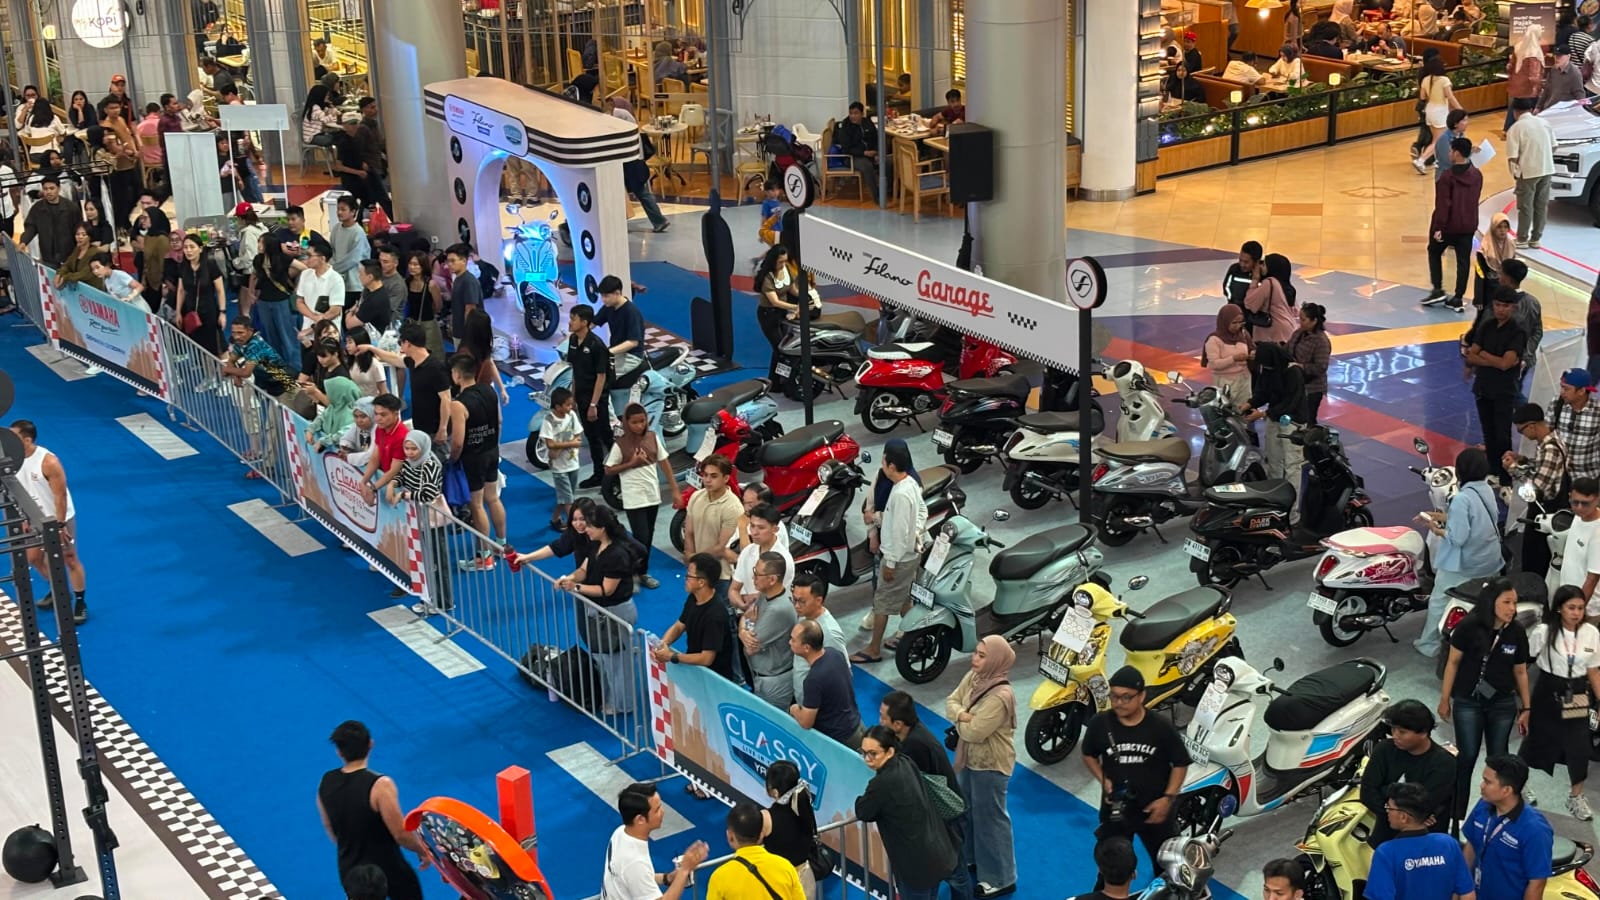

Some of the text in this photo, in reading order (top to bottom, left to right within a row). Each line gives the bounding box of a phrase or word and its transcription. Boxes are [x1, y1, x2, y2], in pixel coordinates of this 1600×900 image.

[863, 256, 994, 318] Filano Garage
[88, 299, 120, 329] YAMAHA
[725, 712, 818, 780] CLASSY
[1106, 743, 1157, 756] MTORCYCLE
[1414, 855, 1446, 868] YAMAHA
